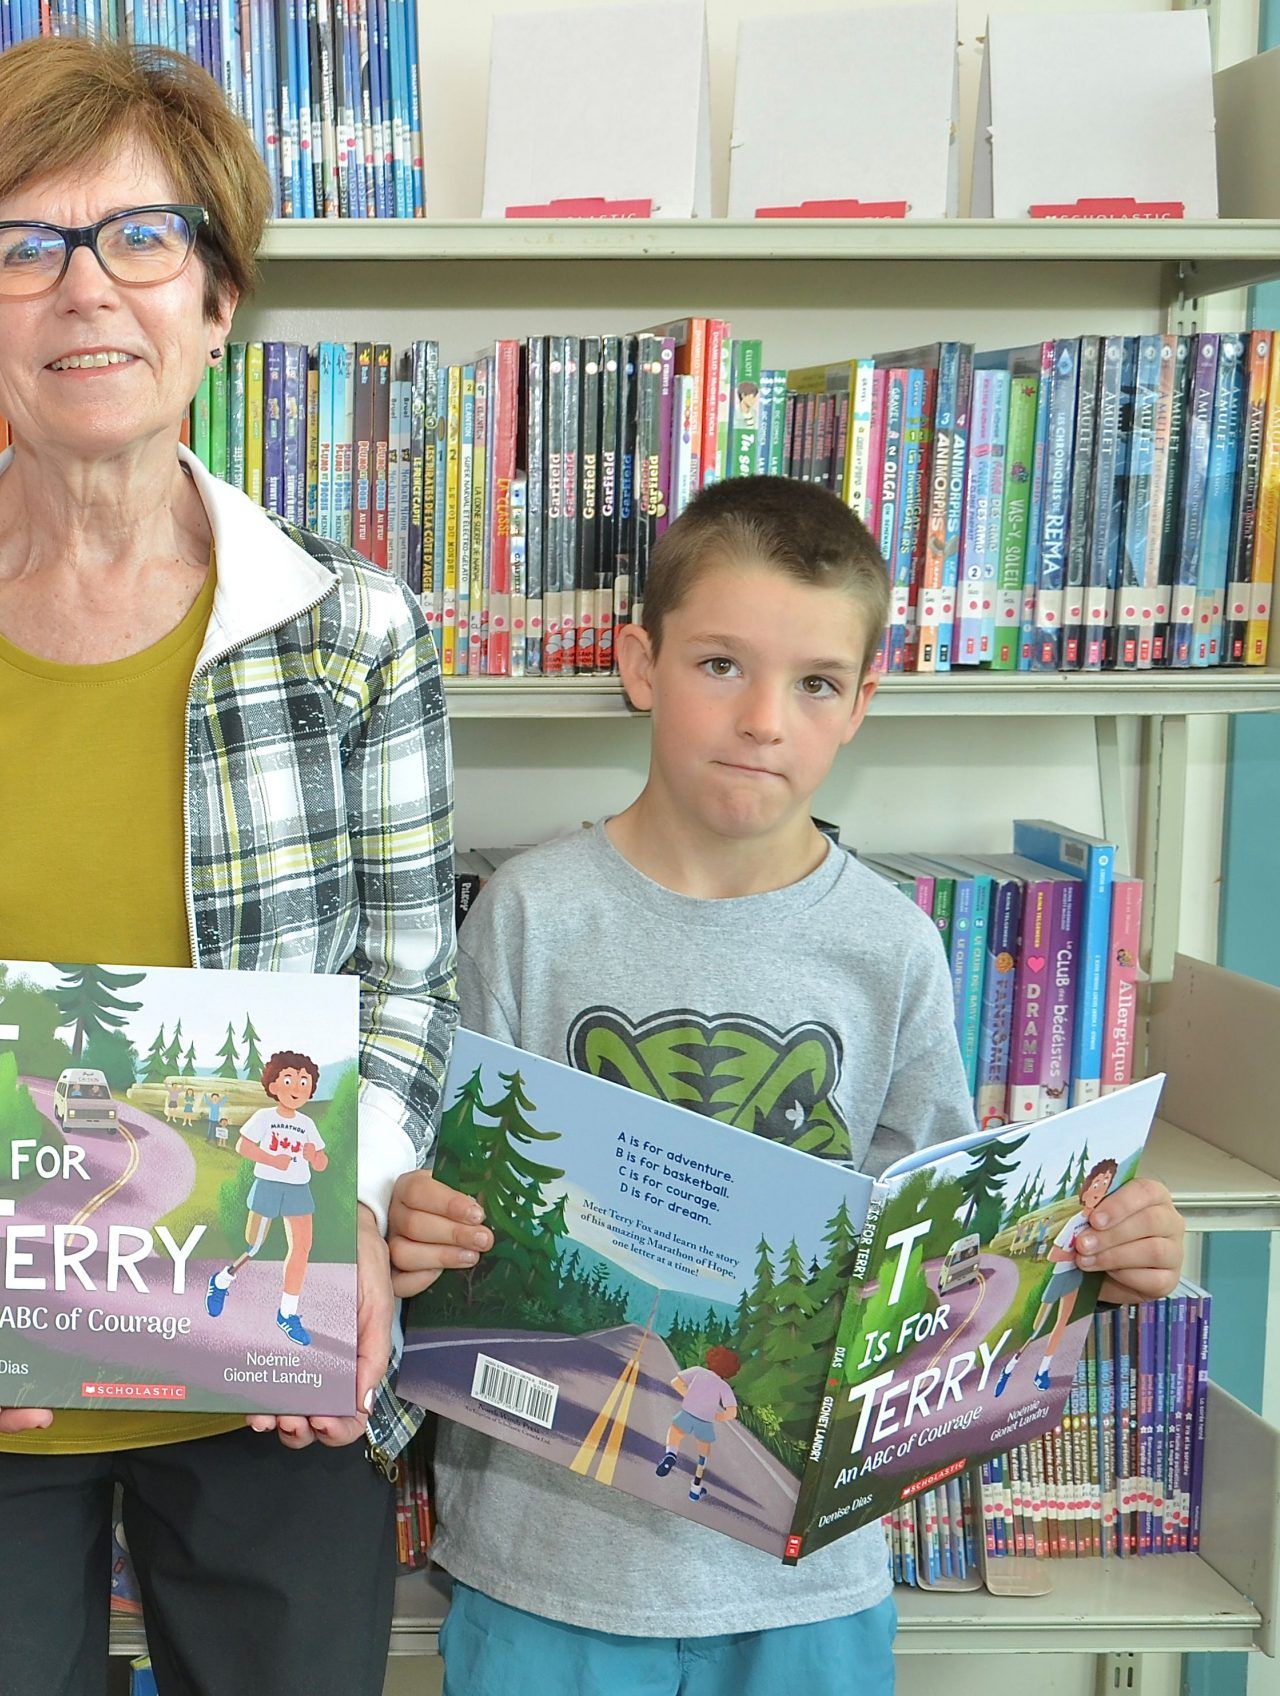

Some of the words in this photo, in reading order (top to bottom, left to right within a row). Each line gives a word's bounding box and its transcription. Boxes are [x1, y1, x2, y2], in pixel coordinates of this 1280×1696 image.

[464, 402, 473, 438] CLANTON
[890, 387, 900, 423] GRAVEL
[1079, 391, 1093, 455] AMULET
[1101, 391, 1115, 456] AMULET
[1139, 392, 1158, 454] AMULET
[1169, 390, 1183, 453] AMULET
[1195, 388, 1211, 450] AMULET
[1216, 386, 1231, 452] AMULET
[425, 445, 435, 460] LES
[1247, 407, 1263, 469] AMULET
[413, 457, 421, 466] LE
[413, 467, 421, 495] PRINCE
[424, 461, 434, 501] PIRATES
[882, 461, 898, 502] OLGA
[931, 431, 951, 533] ANIMORPHS
[1051, 427, 1065, 501] CHRONIQUES
[497, 478, 510, 491] LA
[549, 453, 562, 519] Garfield
[564, 452, 576, 518] Garfield
[582, 454, 596, 520] Garfield
[602, 451, 615, 517] Garfield
[621, 454, 633, 519] Garfield
[648, 455, 660, 516] Garfield
[947, 432, 966, 534] ANIMORPHS
[412, 496, 421, 526] CAPTIF
[424, 502, 433, 514] DE
[424, 516, 433, 528] LA
[496, 497, 510, 537] CLASSE
[423, 530, 434, 554] CÔTE
[1042, 514, 1064, 576] REMA
[422, 555, 432, 593] D'ARGEN
[1023, 983, 1042, 1073] DRAME
[1111, 979, 1133, 1082] Allergique
[271, 1123, 306, 1135] MARATHON
[615, 1147, 624, 1158] B
[626, 1152, 636, 1163] is
[640, 1157, 660, 1171] for
[663, 1165, 730, 1199] basketball.
[617, 1132, 626, 1142] A
[629, 1136, 639, 1147] is
[643, 1141, 663, 1156] for
[666, 1152, 734, 1183] adventure.
[618, 1165, 627, 1176] C
[629, 1169, 639, 1181] is
[642, 1174, 663, 1189] for
[666, 1185, 720, 1212] courage.
[620, 1182, 628, 1193] D
[631, 1187, 641, 1199] is
[644, 1192, 665, 1207] for
[668, 1201, 712, 1226] dream.
[583, 1199, 607, 1215] Meet
[608, 1208, 634, 1227] Terry
[635, 1219, 652, 1233] Fox
[653, 1229, 671, 1241] and
[673, 1233, 697, 1250] learn
[699, 1245, 714, 1257] the
[715, 1252, 740, 1269] story
[591, 1216, 605, 1228] his
[606, 1224, 646, 1245] amazing
[647, 1237, 695, 1262] Marathon
[706, 1260, 737, 1280] Hope,
[861, 1223, 877, 1246] FOR
[612, 1238, 629, 1250] one
[630, 1243, 656, 1260] letter
[656, 1255, 666, 1265] at
[674, 1262, 699, 1277] time!
[852, 1248, 871, 1281] TERRY
[885, 1218, 933, 1307] T
[55, 1306, 82, 1332] of
[87, 1310, 191, 1341] Courage
[246, 1352, 300, 1368] Noémie
[832, 1346, 846, 1369] DIAS
[96, 1384, 185, 1399] SCHOLASTIC
[223, 1368, 268, 1385] Gionet
[272, 1369, 322, 1389] Landry
[847, 1329, 1013, 1456] TERRY
[816, 1395, 834, 1432] GIONET
[990, 1421, 1018, 1442] Gionet
[1018, 1405, 1051, 1428] Landry
[1007, 1400, 1040, 1421] Noémie
[808, 1431, 824, 1462] LANDRY
[833, 1466, 857, 1489] An
[859, 1451, 894, 1477] ABC
[895, 1433, 917, 1459] of
[917, 1405, 983, 1448] Courage
[909, 1460, 966, 1494] SCHOLASTIC
[818, 1501, 851, 1528] Denise
[851, 1493, 874, 1511] Dias
